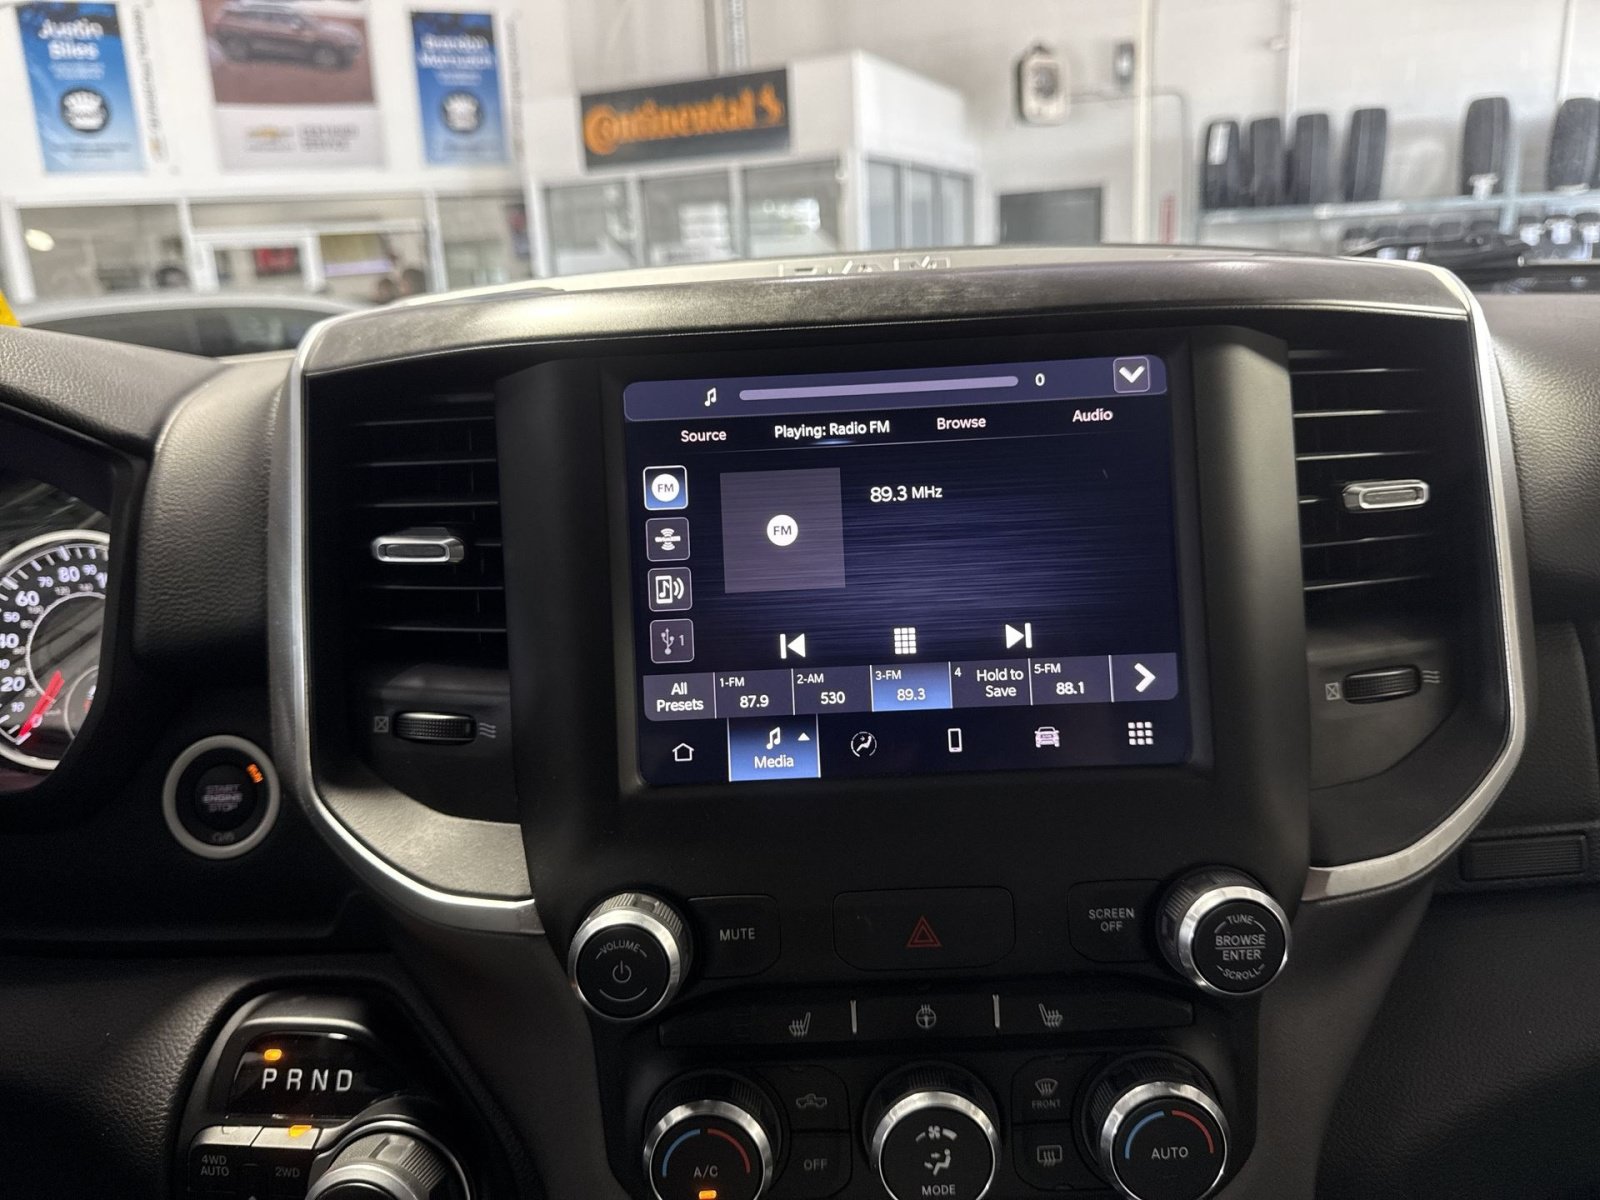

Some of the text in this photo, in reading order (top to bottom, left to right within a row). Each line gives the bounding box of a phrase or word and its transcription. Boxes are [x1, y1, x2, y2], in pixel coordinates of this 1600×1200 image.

[584, 87, 756, 156] Continental
[1035, 373, 1045, 386] 0
[1072, 408, 1113, 423] Audio
[774, 420, 890, 440] Playing: Radio FM
[936, 416, 987, 430] Browse
[680, 429, 727, 443] Source
[657, 482, 674, 493] FM
[870, 485, 943, 503] 89.3 MHz
[773, 525, 792, 536] FM
[57, 565, 81, 583] 80
[15, 590, 40, 607] 60
[679, 634, 685, 646] 1
[875, 670, 902, 682] 3-FM
[954, 667, 962, 678] 4
[976, 668, 1024, 683] Hold to
[1034, 663, 1061, 675] 5-FM
[0, 676, 26, 692] 20
[719, 677, 745, 688] 1-FM
[796, 673, 824, 685] 2-AM
[671, 683, 688, 696] All
[897, 688, 926, 702] 89.3
[985, 685, 1017, 698] Save
[1056, 681, 1085, 695] 88.1
[739, 694, 769, 709] 87.9
[820, 691, 846, 705] 530
[656, 699, 705, 713] Presets
[754, 755, 794, 769] Media
[1088, 908, 1135, 921] SCREEN
[1227, 914, 1254, 926] TUNE
[1100, 920, 1124, 932] OFF
[719, 928, 756, 942] MUTE
[1215, 935, 1266, 948] BROWSE
[600, 940, 640, 955] VOLUME
[1222, 949, 1262, 961] ENTER
[1222, 966, 1262, 981] SCROLL
[262, 1068, 354, 1092] P R N D
[201, 1154, 228, 1166] 4WD
[1150, 1146, 1190, 1160] AUTO
[200, 1165, 230, 1177] AUTO
[692, 1165, 719, 1178] A/C
[803, 1158, 828, 1171] OFF
[274, 1166, 301, 1178] 2WD
[921, 1183, 957, 1197] MODE
